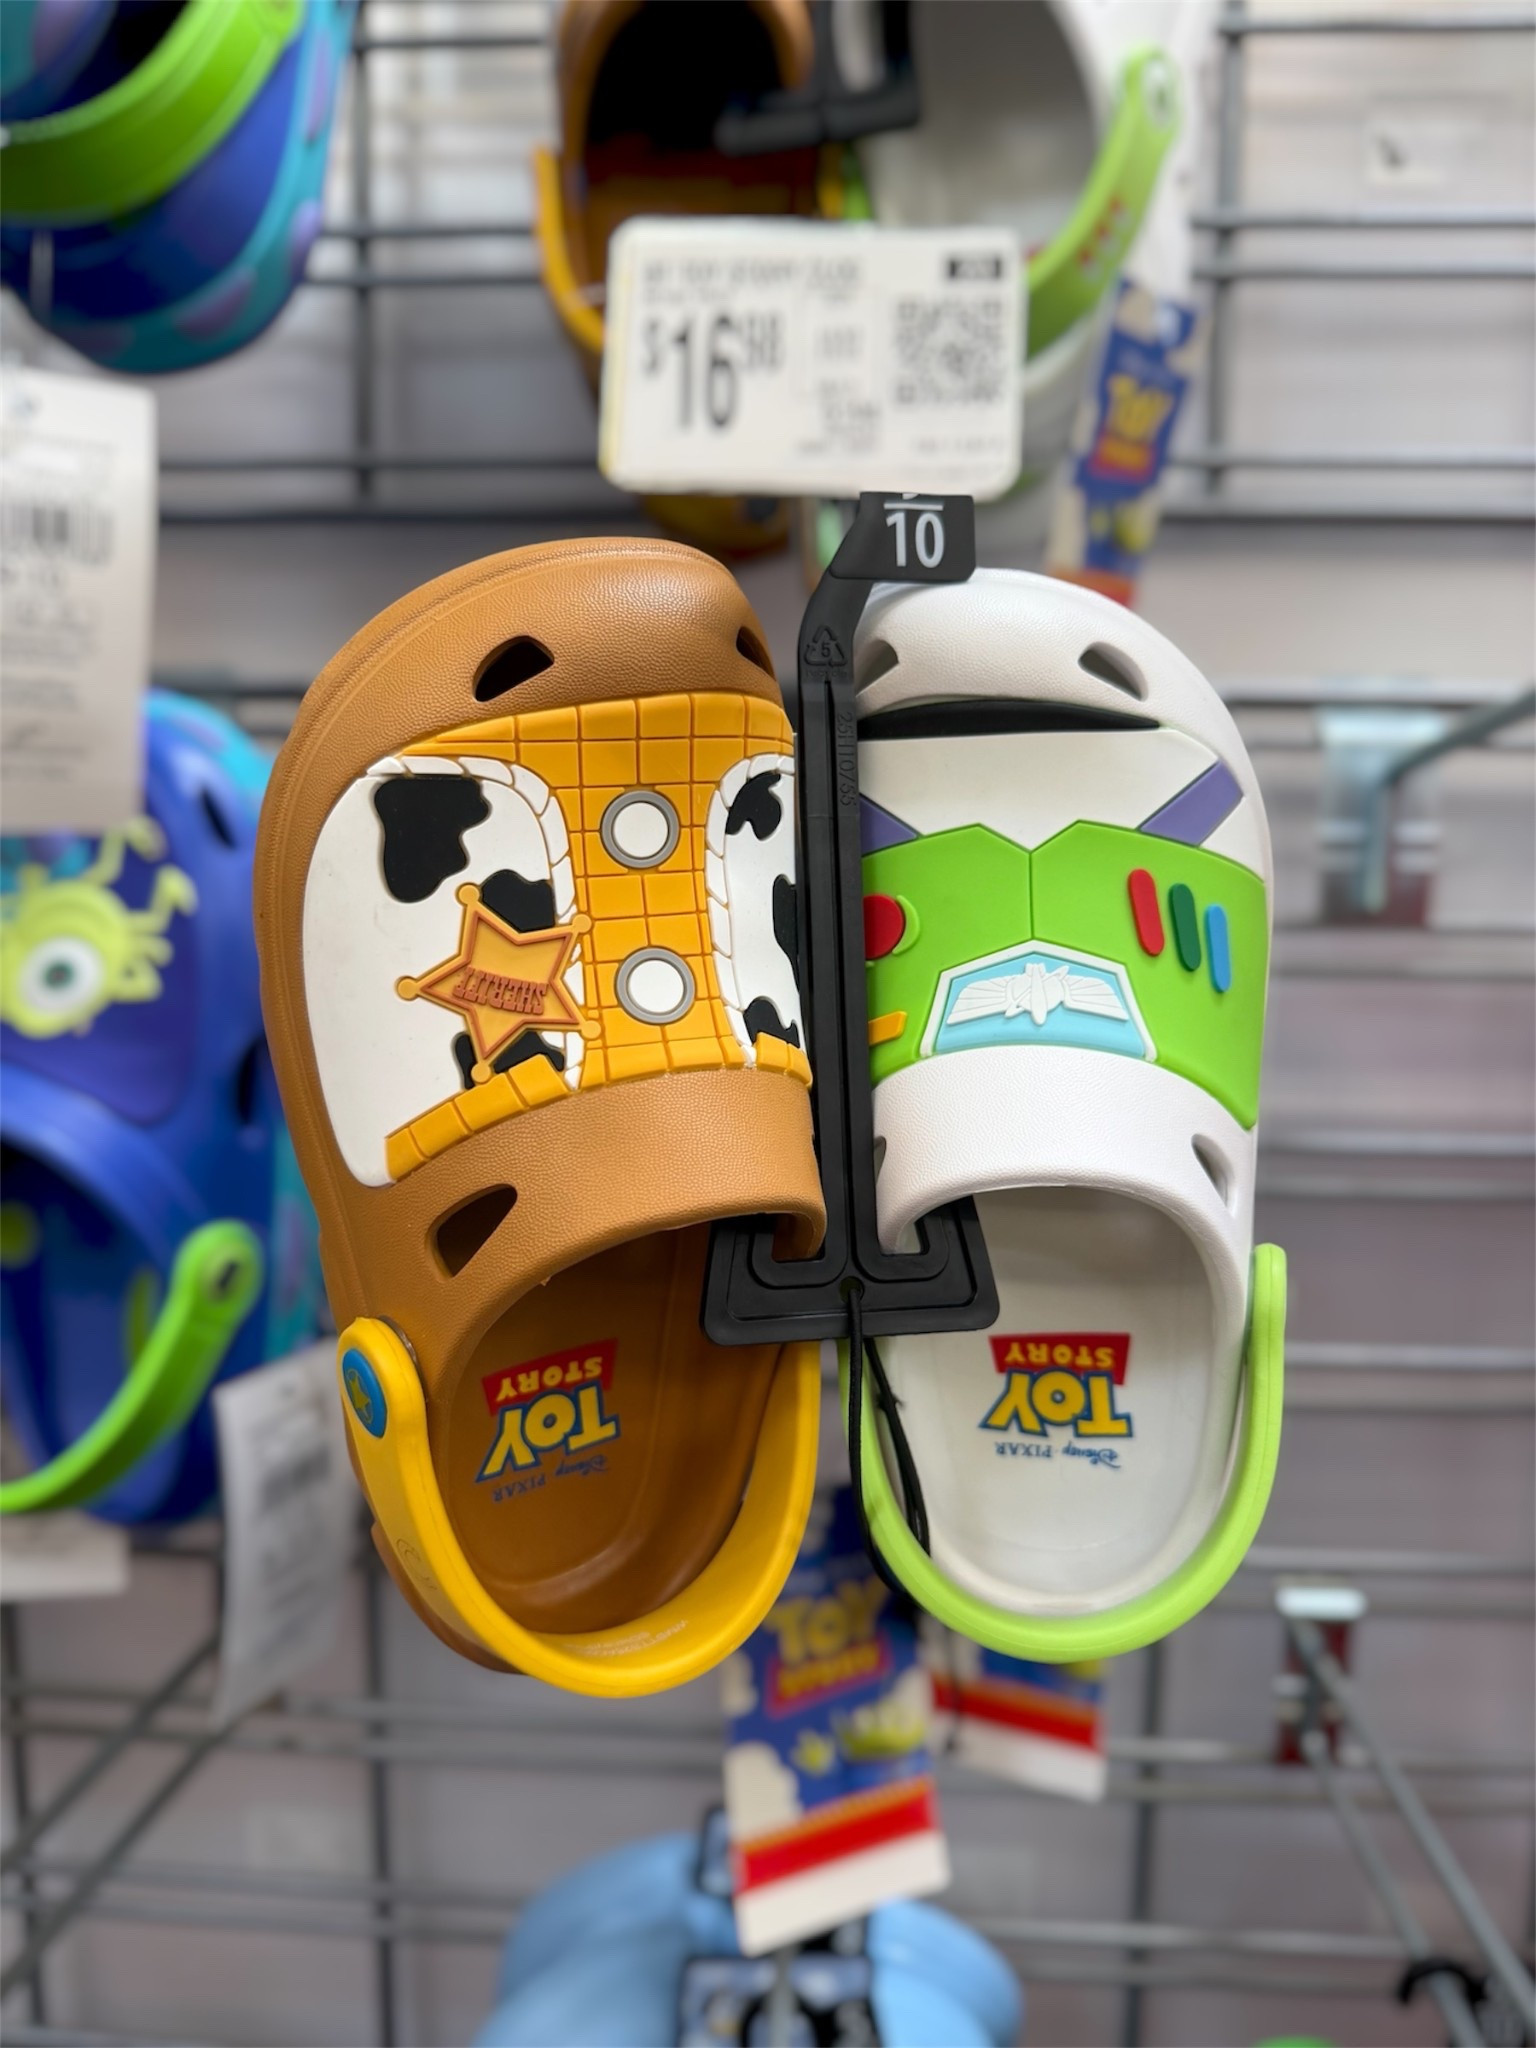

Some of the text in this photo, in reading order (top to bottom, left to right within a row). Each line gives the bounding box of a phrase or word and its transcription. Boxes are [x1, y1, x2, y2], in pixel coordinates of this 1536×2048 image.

[885, 511, 945, 569] 10
[820, 641, 832, 658] 5
[452, 966, 549, 1015] SHERIFF
[1004, 1342, 1114, 1369] STORY
[496, 1356, 603, 1402] STORY
[978, 1367, 1133, 1438] TOY
[476, 1379, 621, 1483] TOY
[995, 1441, 1121, 1469] Disney PIXAR
[493, 1474, 546, 1502] PIXAR
